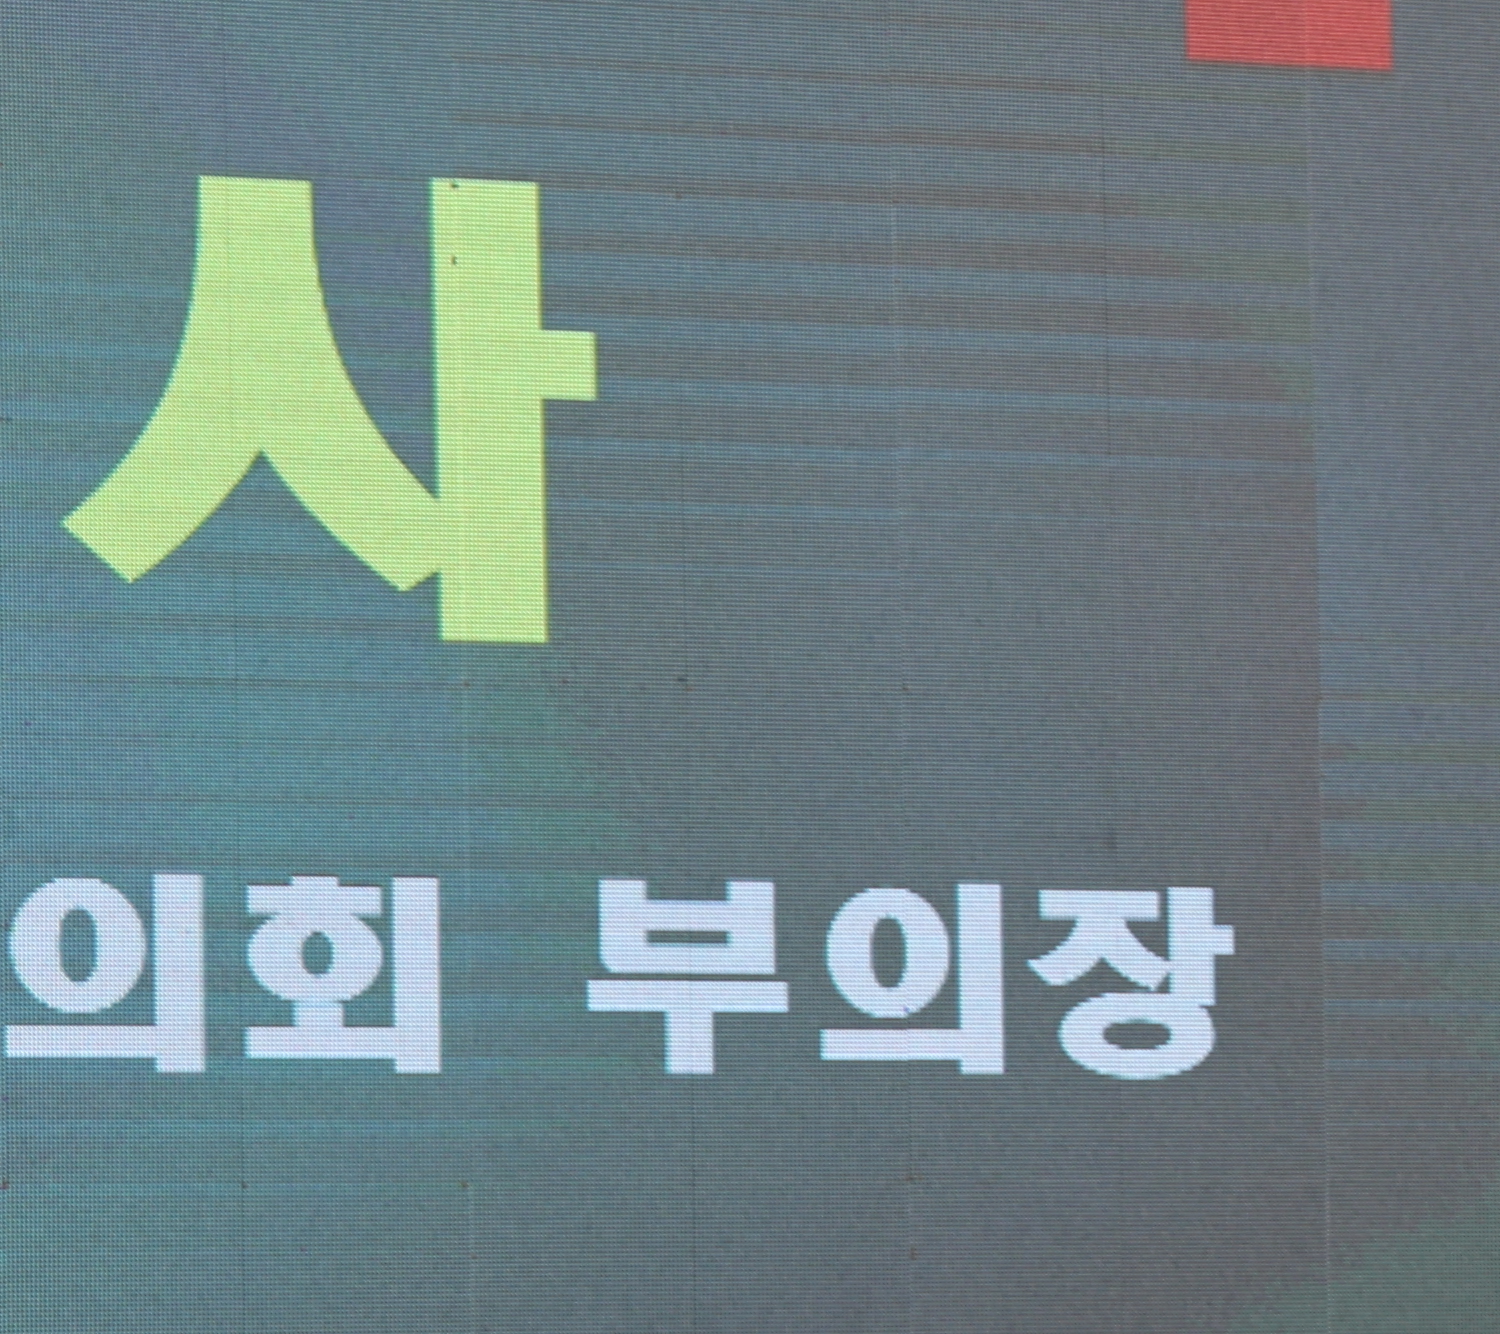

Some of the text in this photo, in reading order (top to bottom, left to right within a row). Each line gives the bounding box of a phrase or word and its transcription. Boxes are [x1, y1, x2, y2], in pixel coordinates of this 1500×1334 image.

[60, 173, 598, 645] 사
[2, 872, 1235, 1080] 의회 부의장
